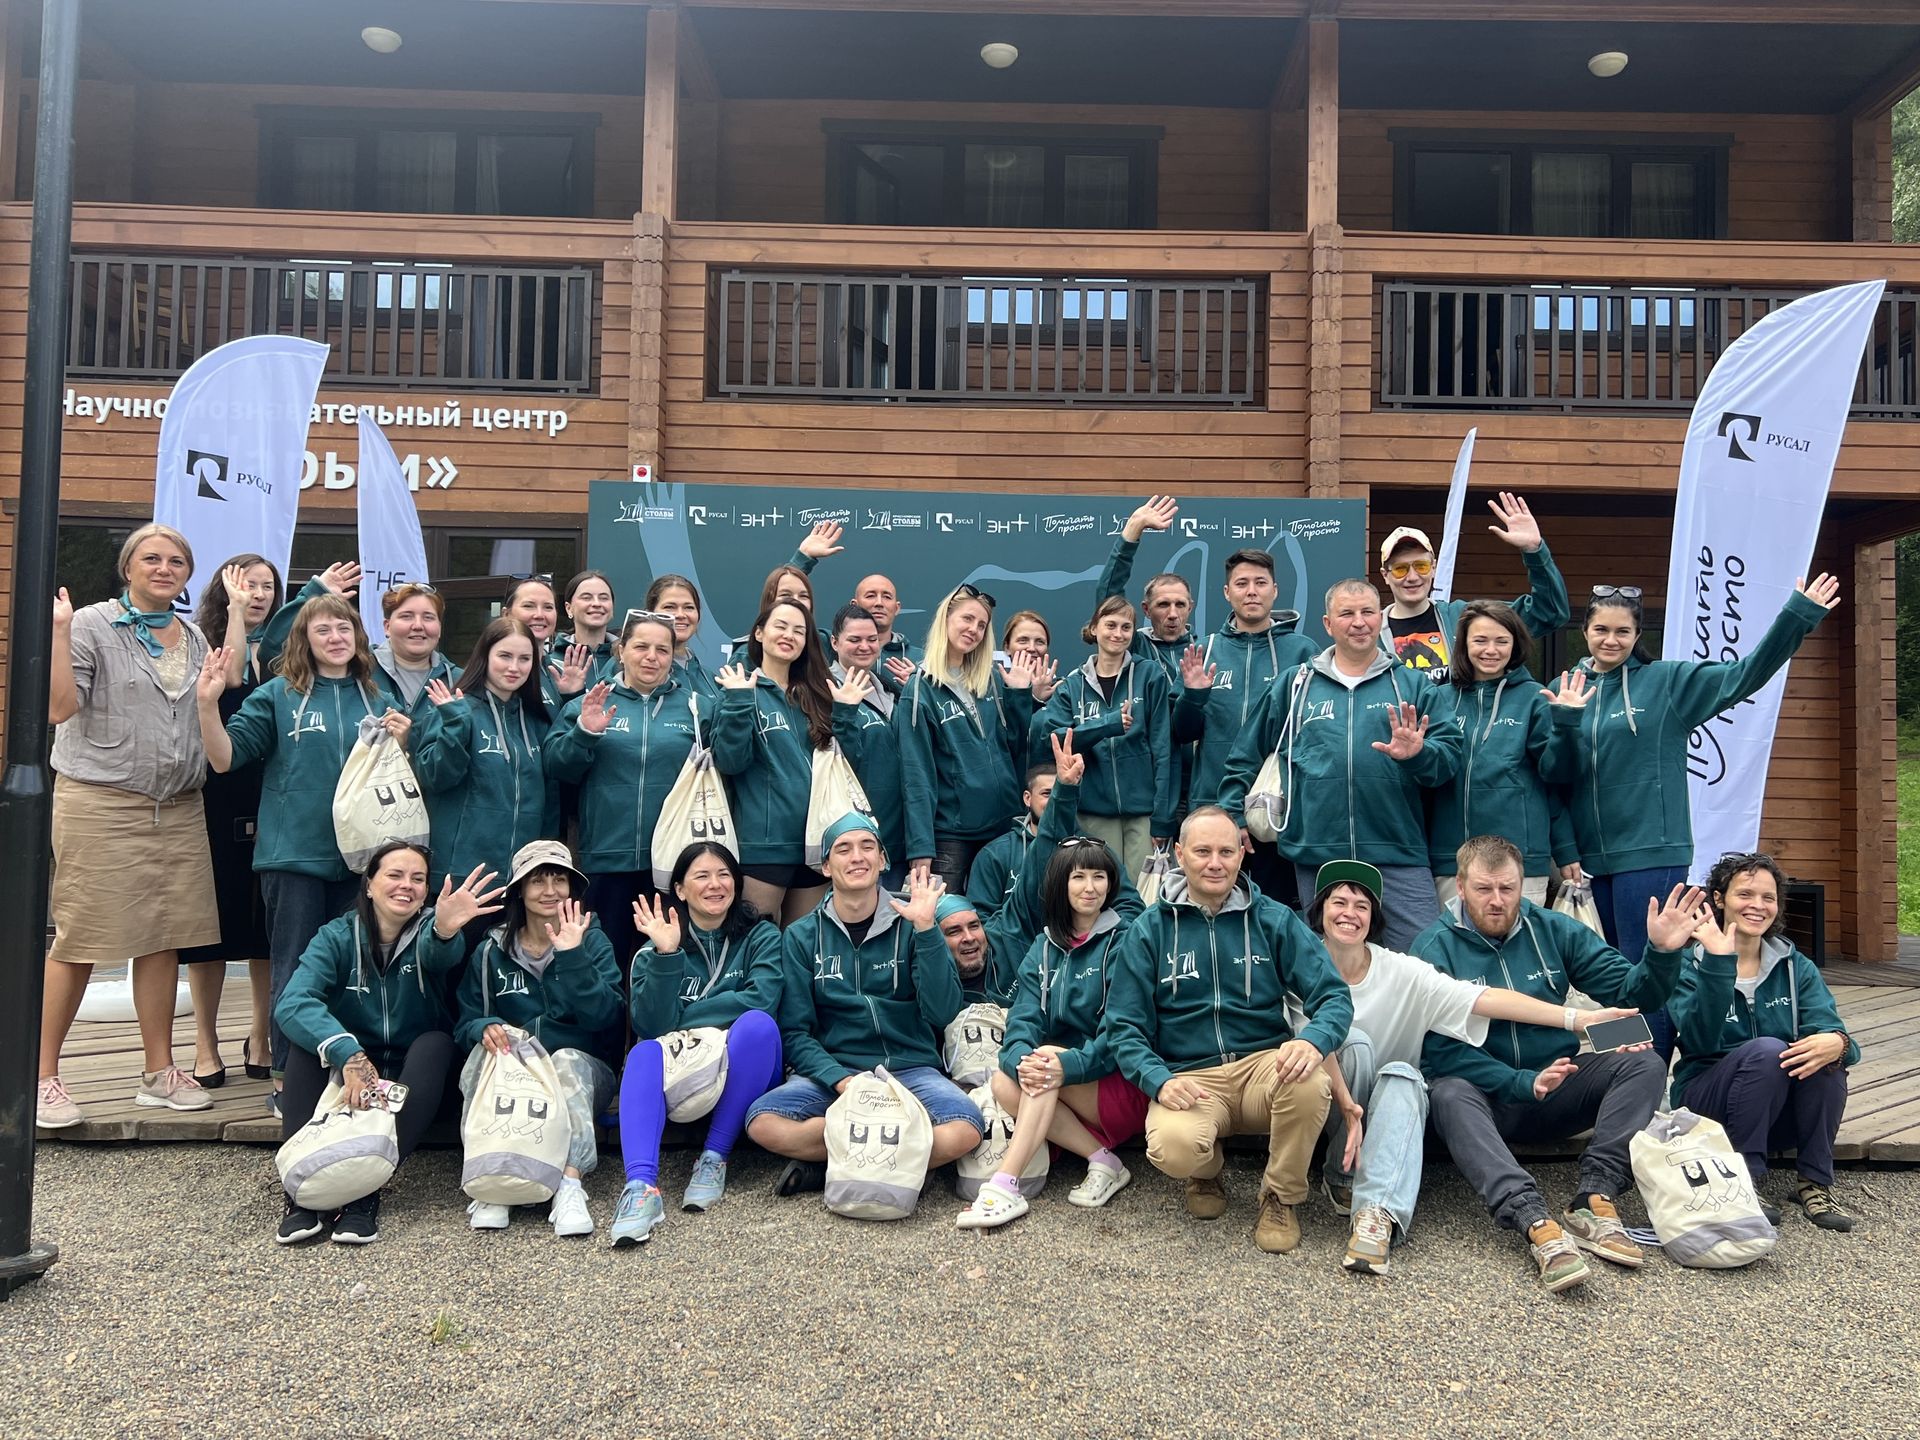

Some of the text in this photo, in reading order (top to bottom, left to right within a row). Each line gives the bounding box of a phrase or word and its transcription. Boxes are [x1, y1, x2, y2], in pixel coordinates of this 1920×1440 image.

[472, 407, 568, 437] центр
[1765, 433, 1811, 453] РУСАЛ
[797, 508, 850, 526] Помогать
[1042, 514, 1095, 533] Помогать
[1058, 523, 1094, 536] просто
[1287, 518, 1341, 537] Помогать
[1304, 527, 1340, 541] просто
[1716, 555, 1755, 725] посто
[1687, 545, 1726, 786] Погать
[858, 1090, 901, 1105] Помогать
[869, 1101, 901, 1111] просто
